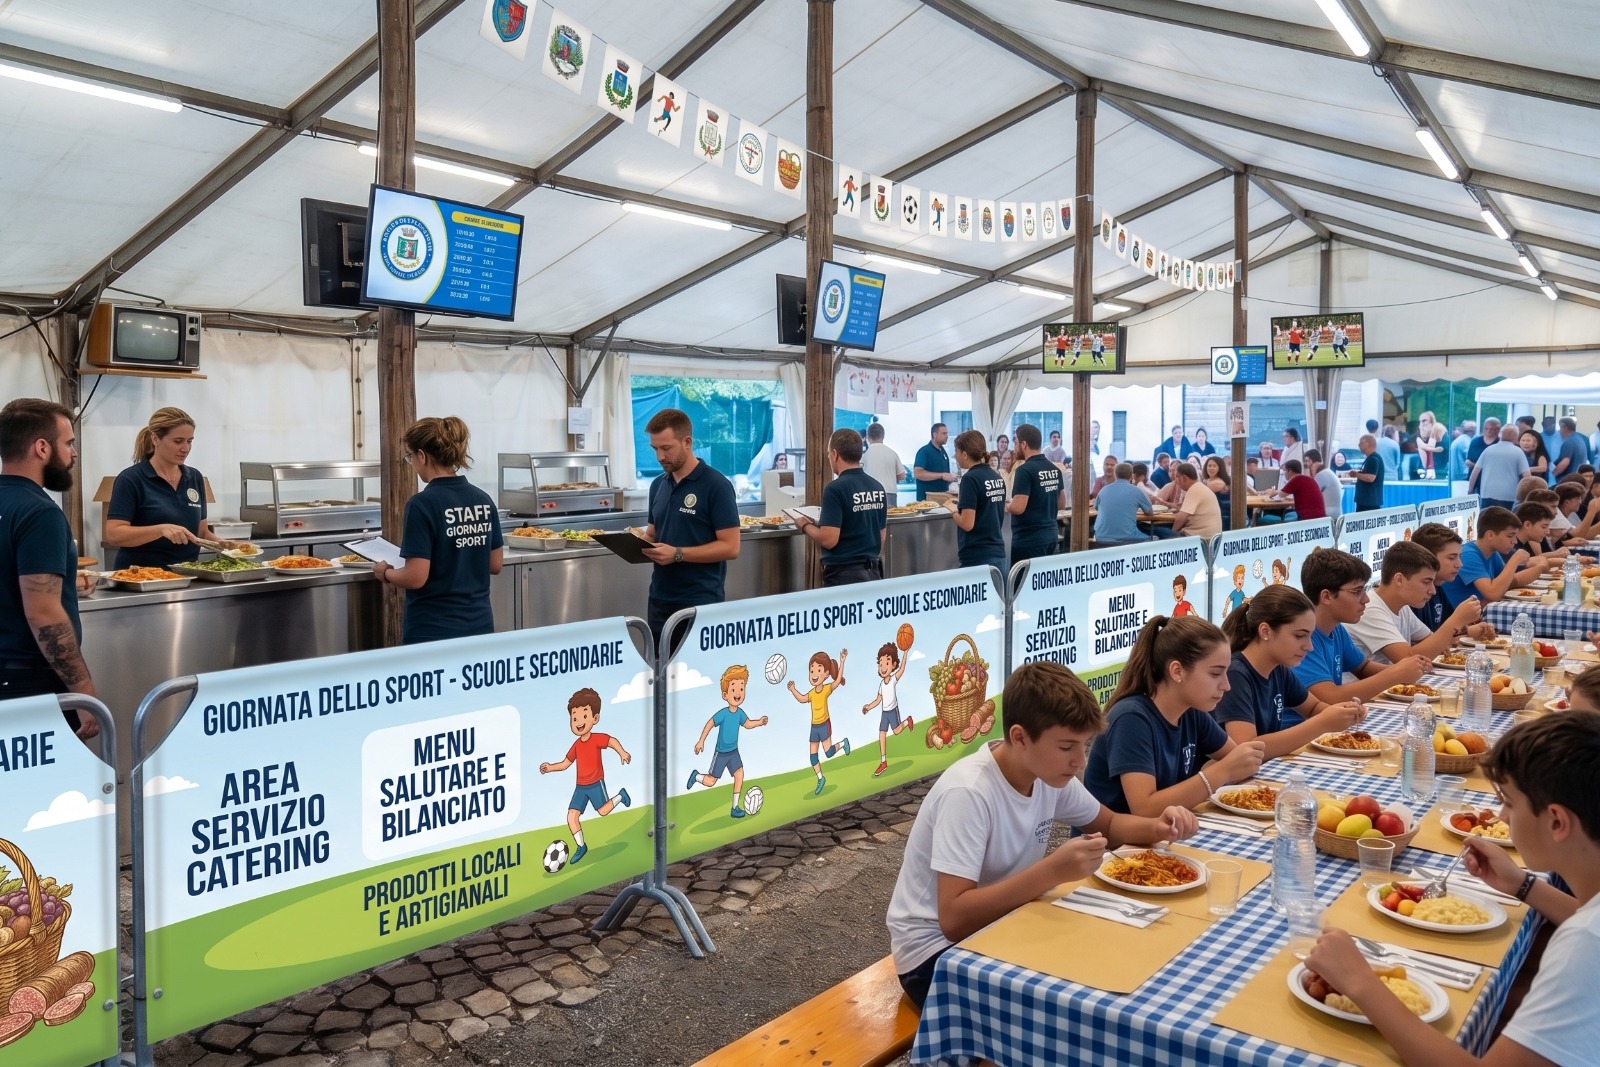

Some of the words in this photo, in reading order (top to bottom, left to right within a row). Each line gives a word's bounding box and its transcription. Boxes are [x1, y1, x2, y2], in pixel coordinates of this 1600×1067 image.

[444, 504, 491, 524] STAFF
[853, 491, 884, 504] STAFF
[446, 522, 492, 537] GIORNATA
[456, 535, 487, 548] SPORT
[1032, 568, 1073, 590] GIORNATA
[1075, 562, 1099, 583] DELLO
[1100, 558, 1124, 578] SPORT
[1132, 554, 1157, 574] SCUOLE
[1158, 547, 1198, 568] SECONDARIE
[700, 616, 773, 651] GIORNATA
[778, 606, 820, 638] DELLO
[824, 602, 864, 629] SPORT
[876, 592, 920, 620] SCUOLE
[923, 582, 988, 612] SECONDARIE
[1037, 606, 1067, 629] AREA
[1094, 612, 1140, 636] SALUTARE
[1142, 610, 1148, 625] E
[1108, 592, 1135, 614] MENU
[1026, 626, 1076, 652] SERVIZIO
[1095, 629, 1141, 655] BILANCIA
[204, 692, 313, 736] GIORNATA
[319, 681, 380, 717] DELLO
[386, 669, 445, 704] SPORT
[462, 656, 524, 691] SCUOLE
[529, 640, 624, 680] SECONDARIE
[414, 727, 475, 766] MENU
[220, 762, 300, 808] AREA
[380, 758, 487, 807] SALUTARE
[494, 752, 506, 780] E
[191, 794, 325, 854] SERVIZIO
[381, 786, 506, 842] BILANCIATO
[187, 830, 330, 897] CATERING
[364, 862, 456, 911] PRODOTTI
[461, 842, 522, 882] LOCALI
[379, 910, 390, 936] E
[396, 874, 509, 932] ARTIGIANALI
